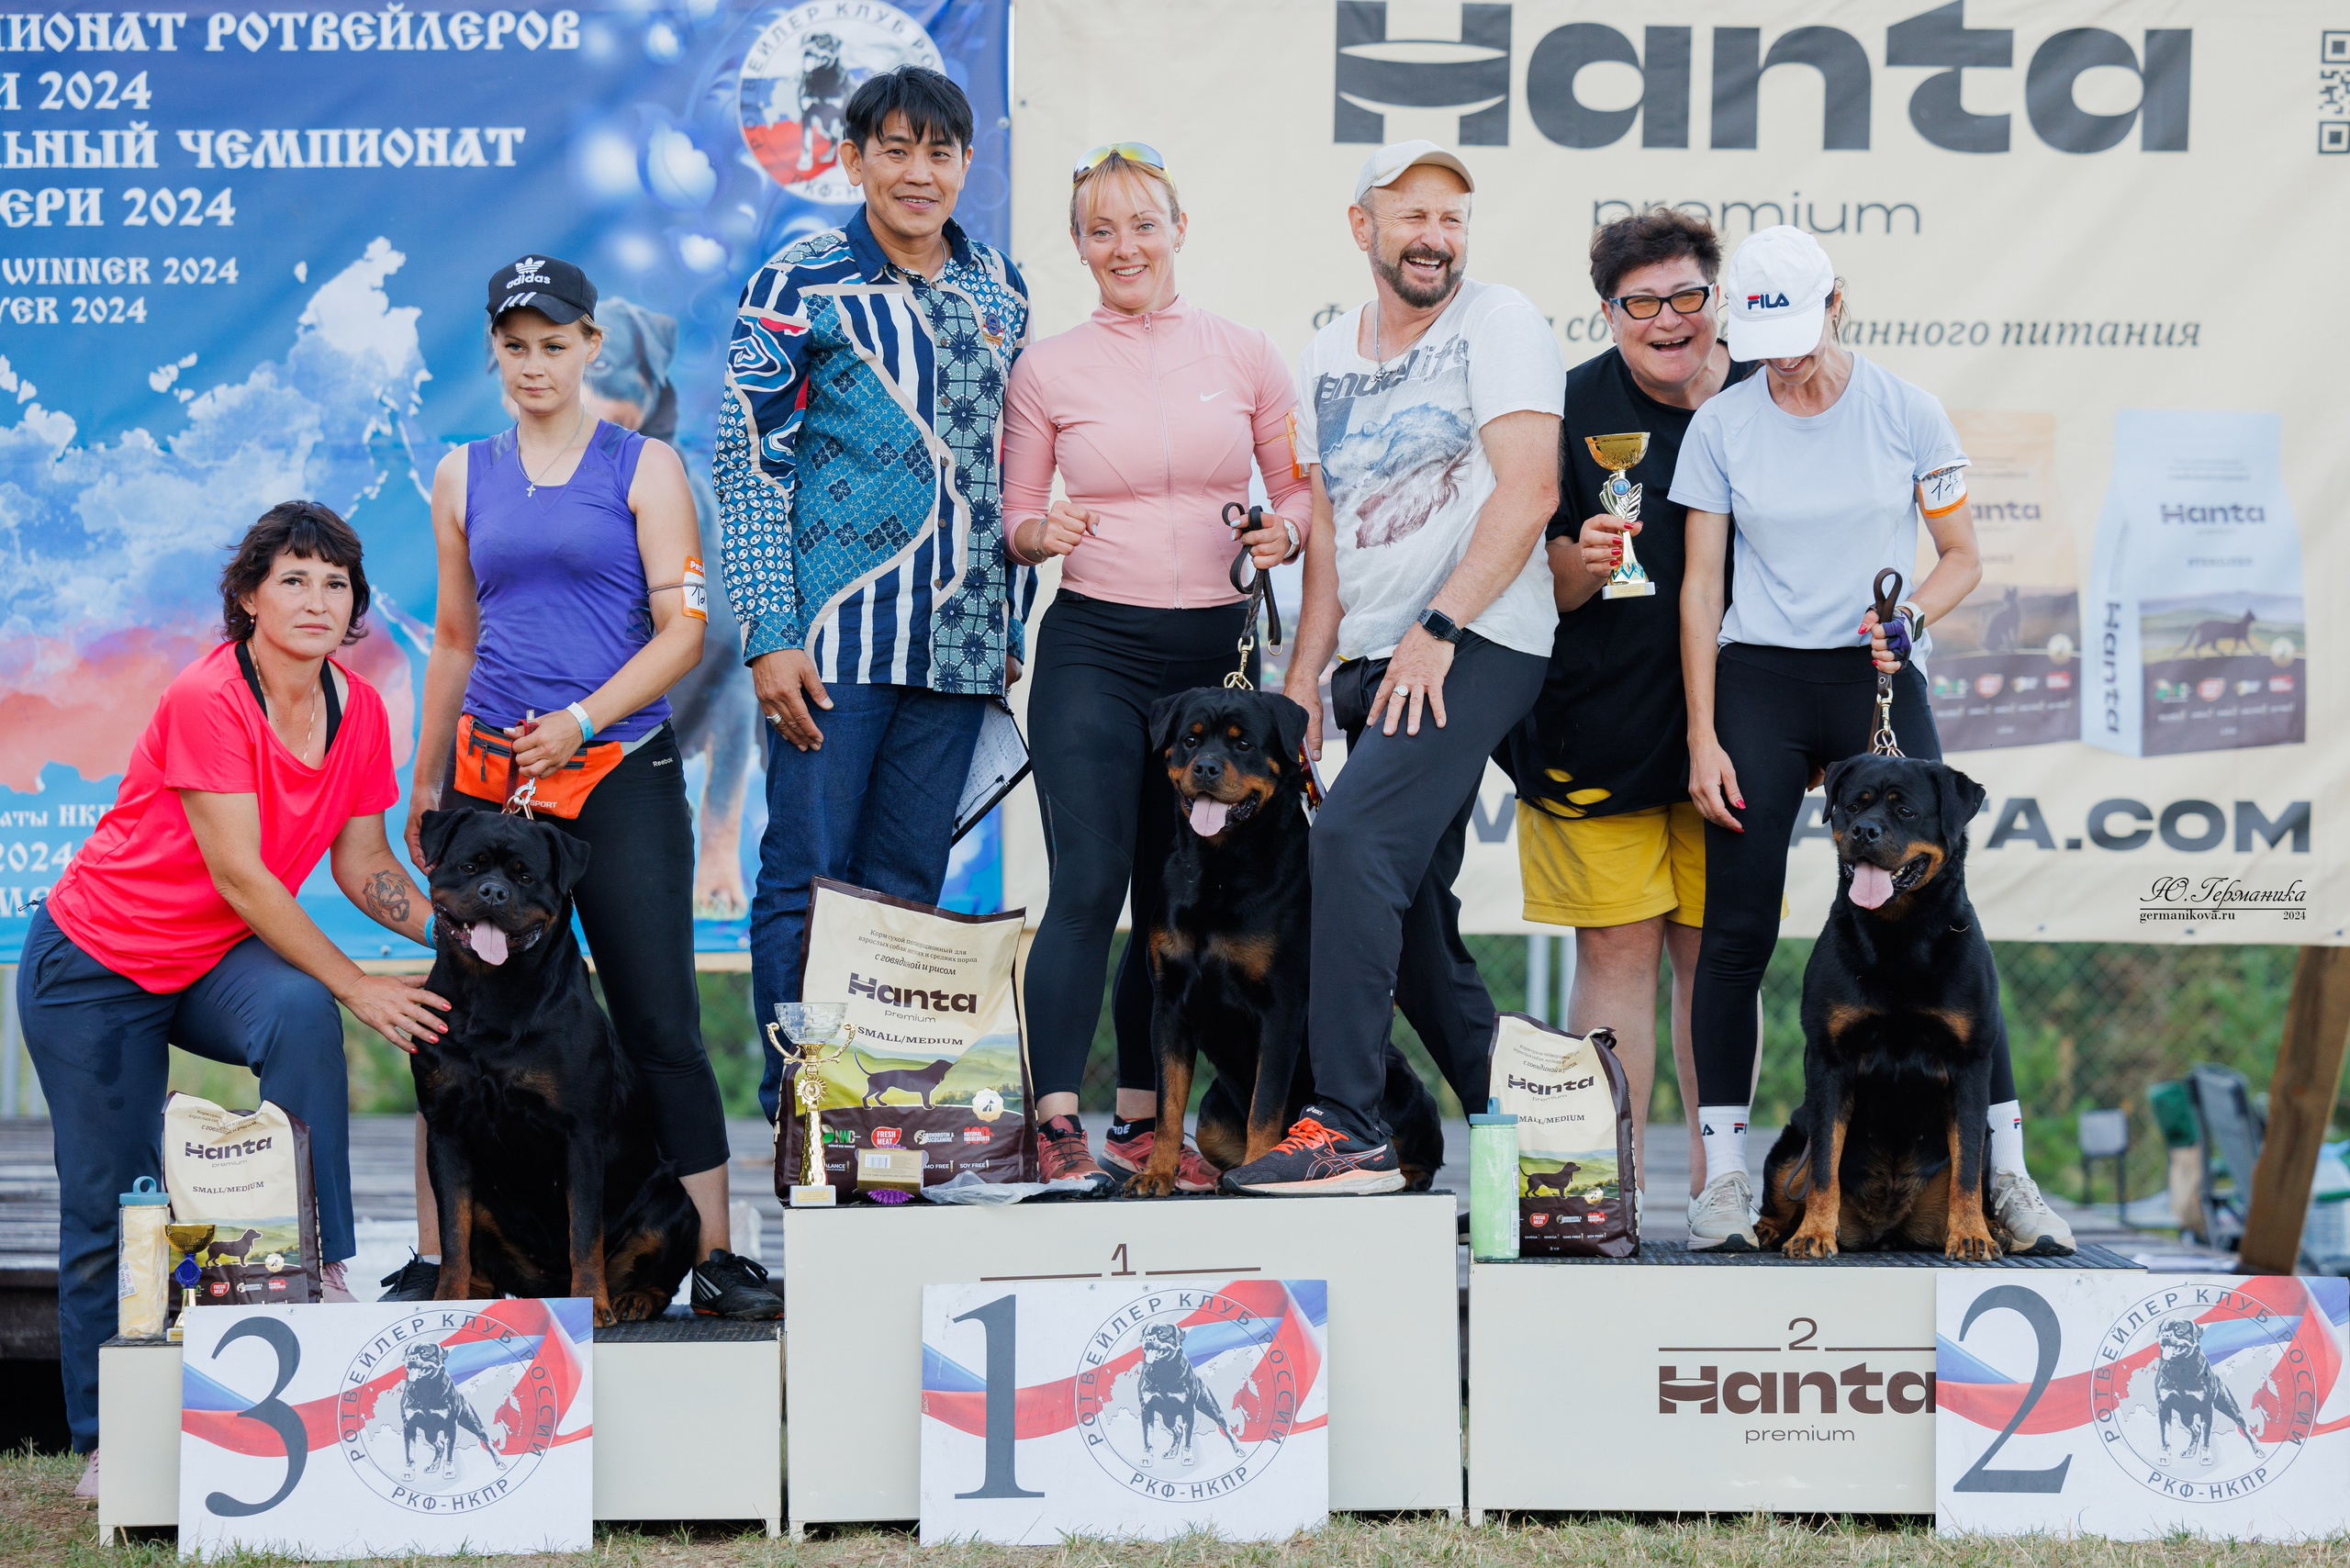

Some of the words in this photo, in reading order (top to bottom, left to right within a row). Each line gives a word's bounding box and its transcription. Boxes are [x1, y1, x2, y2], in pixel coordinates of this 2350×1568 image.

[0, 11, 187, 52] ИОНАТ
[204, 1, 580, 52] РОТВЕЙЛЕРОВ
[38, 70, 152, 110] 2024
[1334, 0, 2191, 154] Hanta
[0, 120, 159, 169] ЬНЫЙ
[175, 127, 526, 169] ЧЕМПИОНАТ
[122, 186, 236, 227] 2024
[2, 257, 151, 286] WINNER
[162, 256, 239, 285] 2024
[506, 274, 551, 289] adidas
[71, 296, 147, 323] 2024
[1747, 293, 1790, 310] FILA
[1999, 321, 2203, 348] питания
[1969, 500, 2041, 522] anta
[2160, 503, 2266, 526] Hanta
[2102, 601, 2121, 735] Hanta
[653, 757, 673, 767] Reebok
[870, 929, 888, 940] Корм
[890, 942, 907, 952] собак
[930, 953, 957, 962] средних
[928, 965, 957, 976] рисом
[847, 972, 978, 1014] Hanta
[884, 1010, 936, 1024] premium
[858, 1025, 964, 1046] SMALL/MEDIUM
[1507, 1074, 1595, 1096] Hanta
[1532, 1092, 1568, 1102] premium
[1518, 1114, 1585, 1126] MALL/MEDIUM
[185, 1137, 273, 1160] Hanta
[834, 1130, 856, 1144] NWC
[211, 1159, 248, 1169] premium
[192, 1181, 264, 1194] SMALL/MEDIUM
[1111, 1243, 1136, 1276] 1
[1788, 1316, 1818, 1350] 2
[1079, 1296, 1162, 1448] РОТВЕЙЛЕР
[1180, 1293, 1252, 1326] КЛУБ
[1258, 1329, 1292, 1446] РОССИИ
[2094, 1292, 2179, 1444] РОТВЕЙЛЕР
[2196, 1288, 2272, 1325] КЛУБ
[2277, 1328, 2312, 1447] РОССИИ
[349, 1317, 425, 1463] РОТВЕЙЛЕР
[442, 1313, 515, 1345] КЛУБ
[519, 1349, 554, 1459] РОССИИ
[953, 1294, 1046, 1500] 1
[1659, 1361, 1937, 1415] Hanta
[1953, 1284, 2074, 1494] 2
[206, 1316, 308, 1518] 3
[1745, 1424, 1855, 1444] premium
[390, 1478, 509, 1511] РКФ-НКПР
[1129, 1466, 1248, 1500] РКФ-НКПР
[2147, 1467, 2268, 1500] РКФ-НКПР
